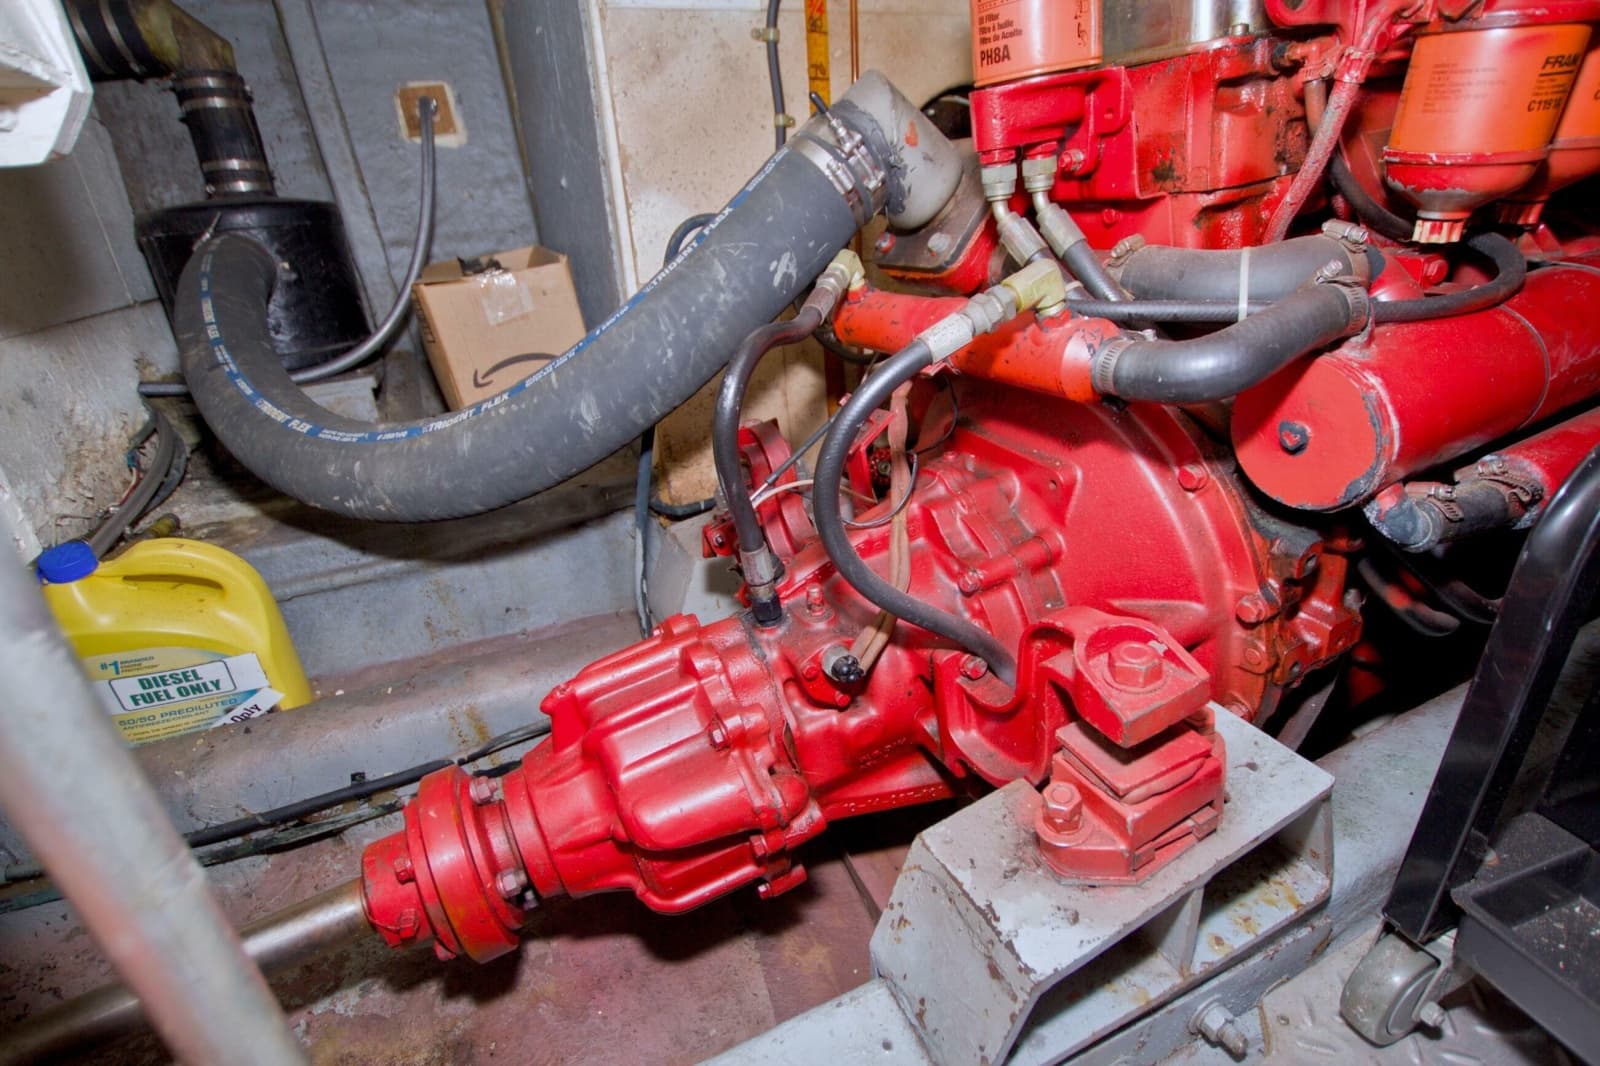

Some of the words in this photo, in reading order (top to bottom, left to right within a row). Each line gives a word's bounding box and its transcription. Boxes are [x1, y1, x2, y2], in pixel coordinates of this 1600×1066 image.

[980, 44, 1011, 68] PH8A
[652, 239, 699, 289] TRIDENT
[703, 206, 734, 237] FLEX
[429, 408, 476, 433] TRIDENT
[481, 391, 510, 413] FLEX
[288, 419, 313, 434] FLEX
[138, 669, 203, 689] DIESEL
[129, 688, 175, 707] FUEL
[176, 679, 221, 698] ONLY
[118, 714, 157, 727] 50/50
[160, 698, 237, 718] PREDILUTED
[231, 703, 262, 723] Only
